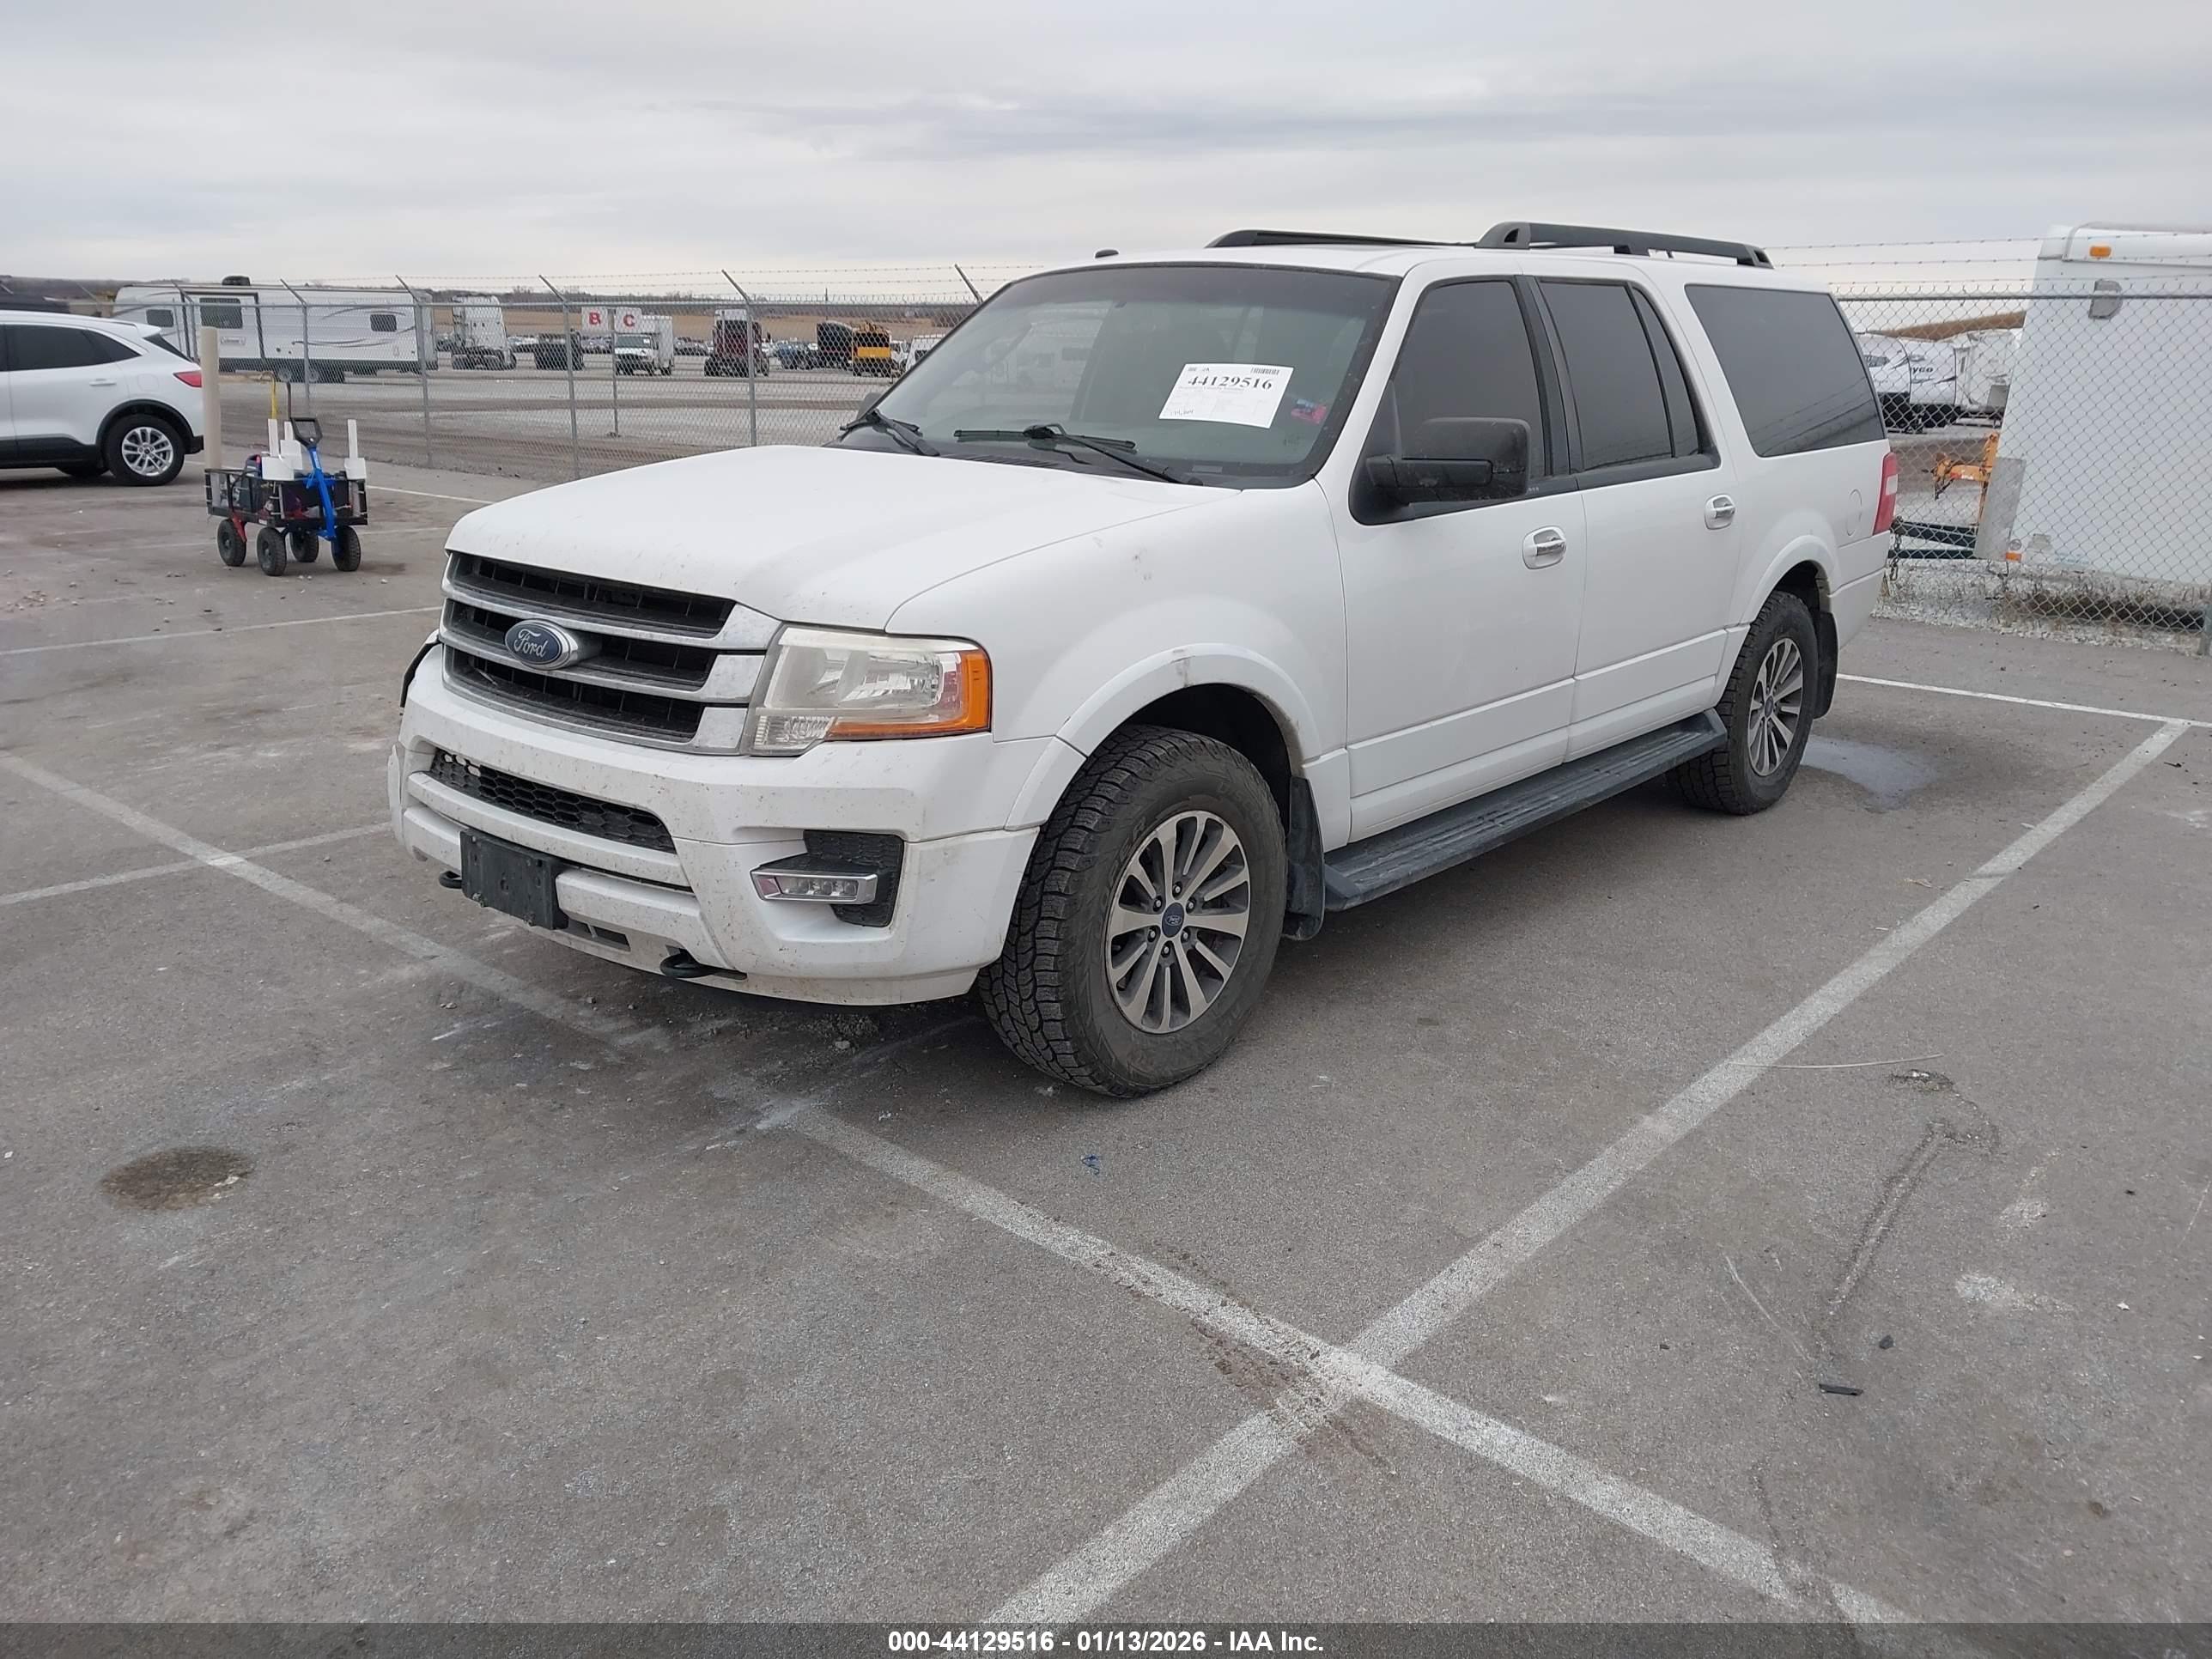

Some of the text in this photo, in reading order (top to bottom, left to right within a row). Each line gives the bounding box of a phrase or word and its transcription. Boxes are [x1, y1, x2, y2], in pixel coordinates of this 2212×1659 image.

[588, 312, 601, 325] B
[622, 313, 636, 327] C
[1188, 375, 1273, 391] 44129516
[514, 628, 549, 658] Ford
